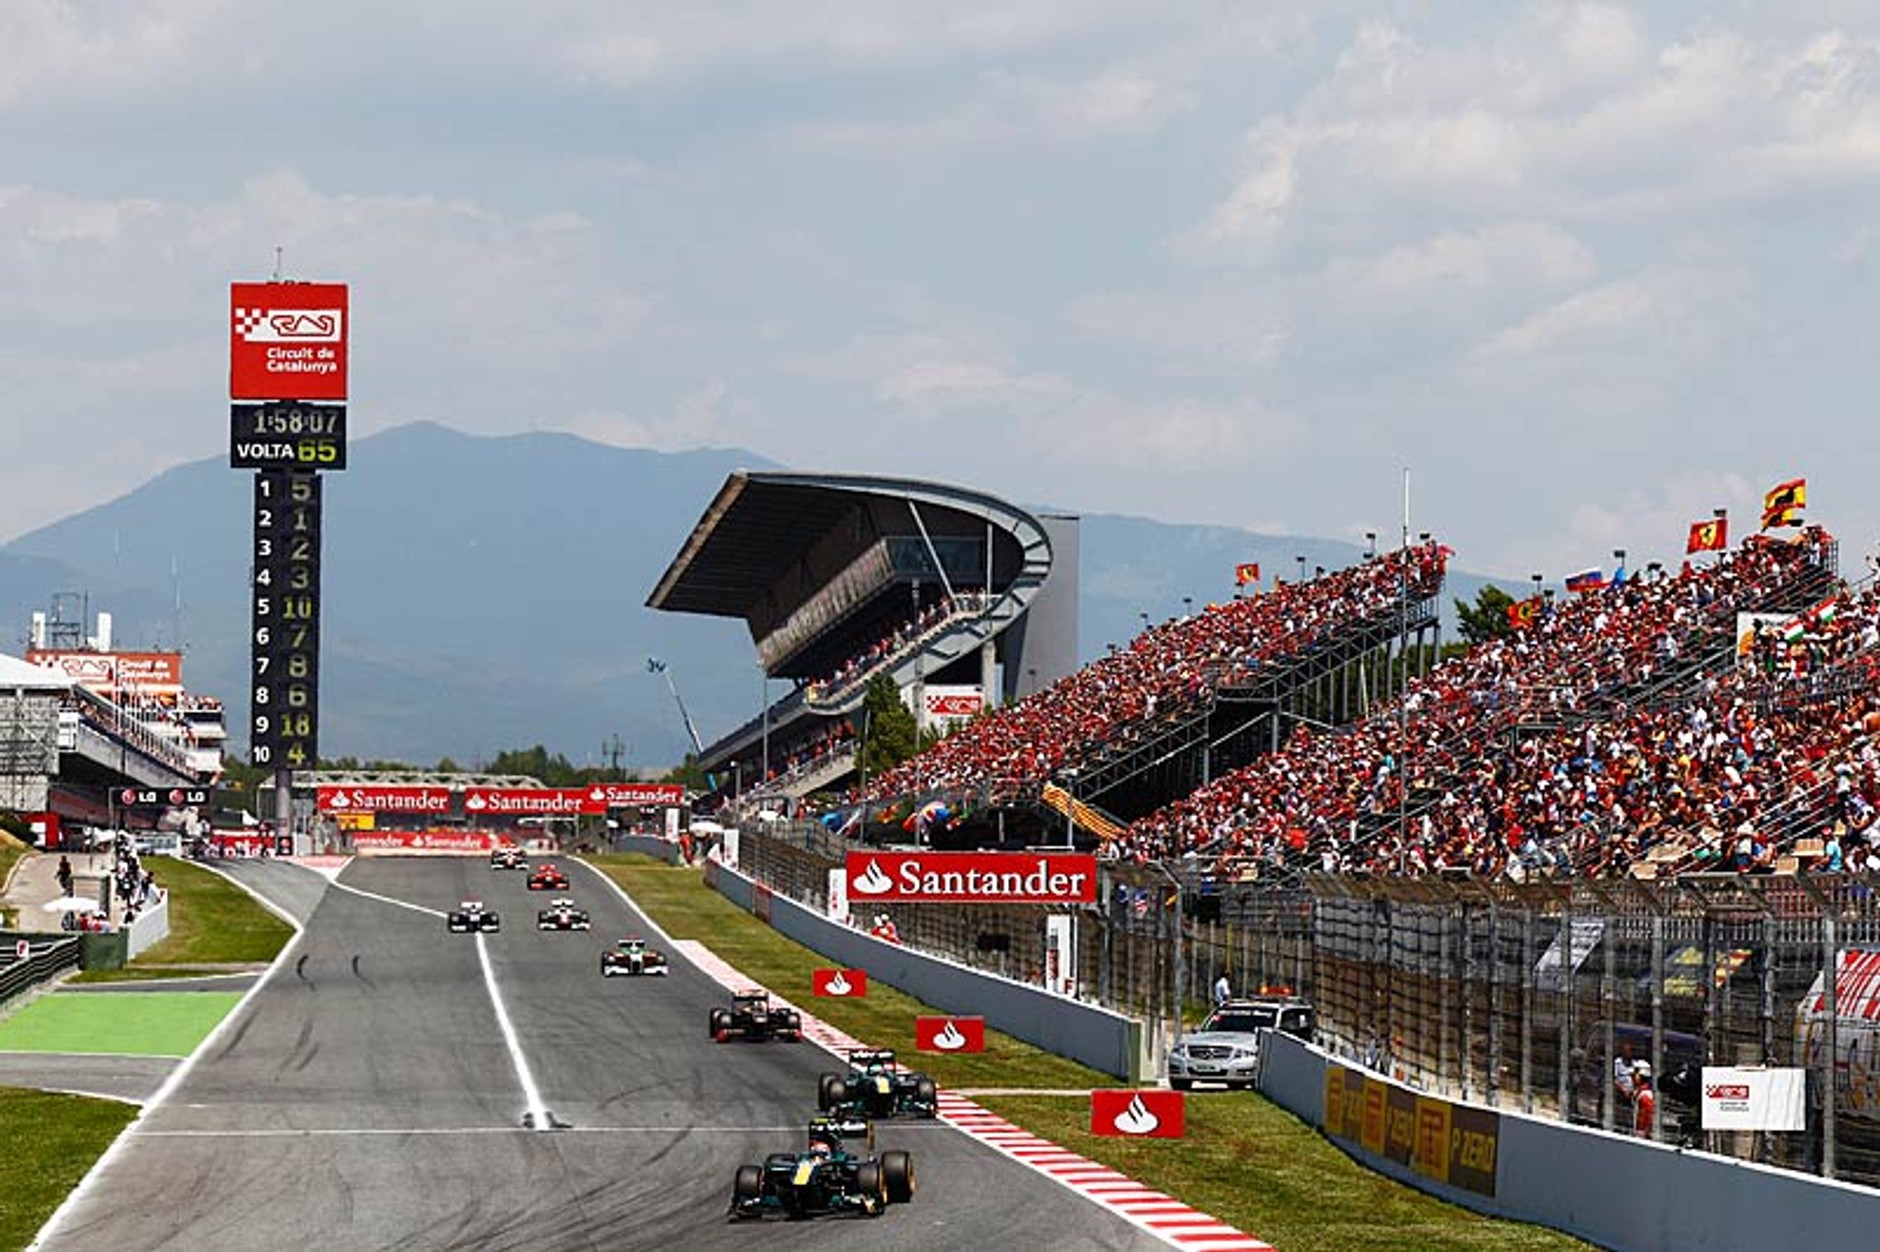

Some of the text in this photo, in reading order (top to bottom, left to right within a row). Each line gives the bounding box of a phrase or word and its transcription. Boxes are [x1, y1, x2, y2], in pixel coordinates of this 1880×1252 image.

[267, 348, 335, 359] Circuit de
[267, 361, 337, 374] Catalunya
[237, 438, 337, 462] VOLTA 65
[260, 476, 312, 502] 1 5
[258, 508, 308, 531] 2 1
[258, 535, 310, 562] 3 2
[256, 566, 310, 590] 4 3
[257, 596, 312, 620] 5 10
[256, 624, 306, 649] 6 7
[256, 654, 308, 679] 7 8
[255, 686, 269, 704] 8
[255, 716, 270, 734] 9
[253, 743, 306, 766] 10 4
[139, 792, 156, 802] LG
[187, 791, 205, 802] LG
[352, 790, 448, 809] Santander
[488, 792, 583, 810] Santander
[606, 786, 678, 802] Santander
[899, 860, 1085, 895] Santander
